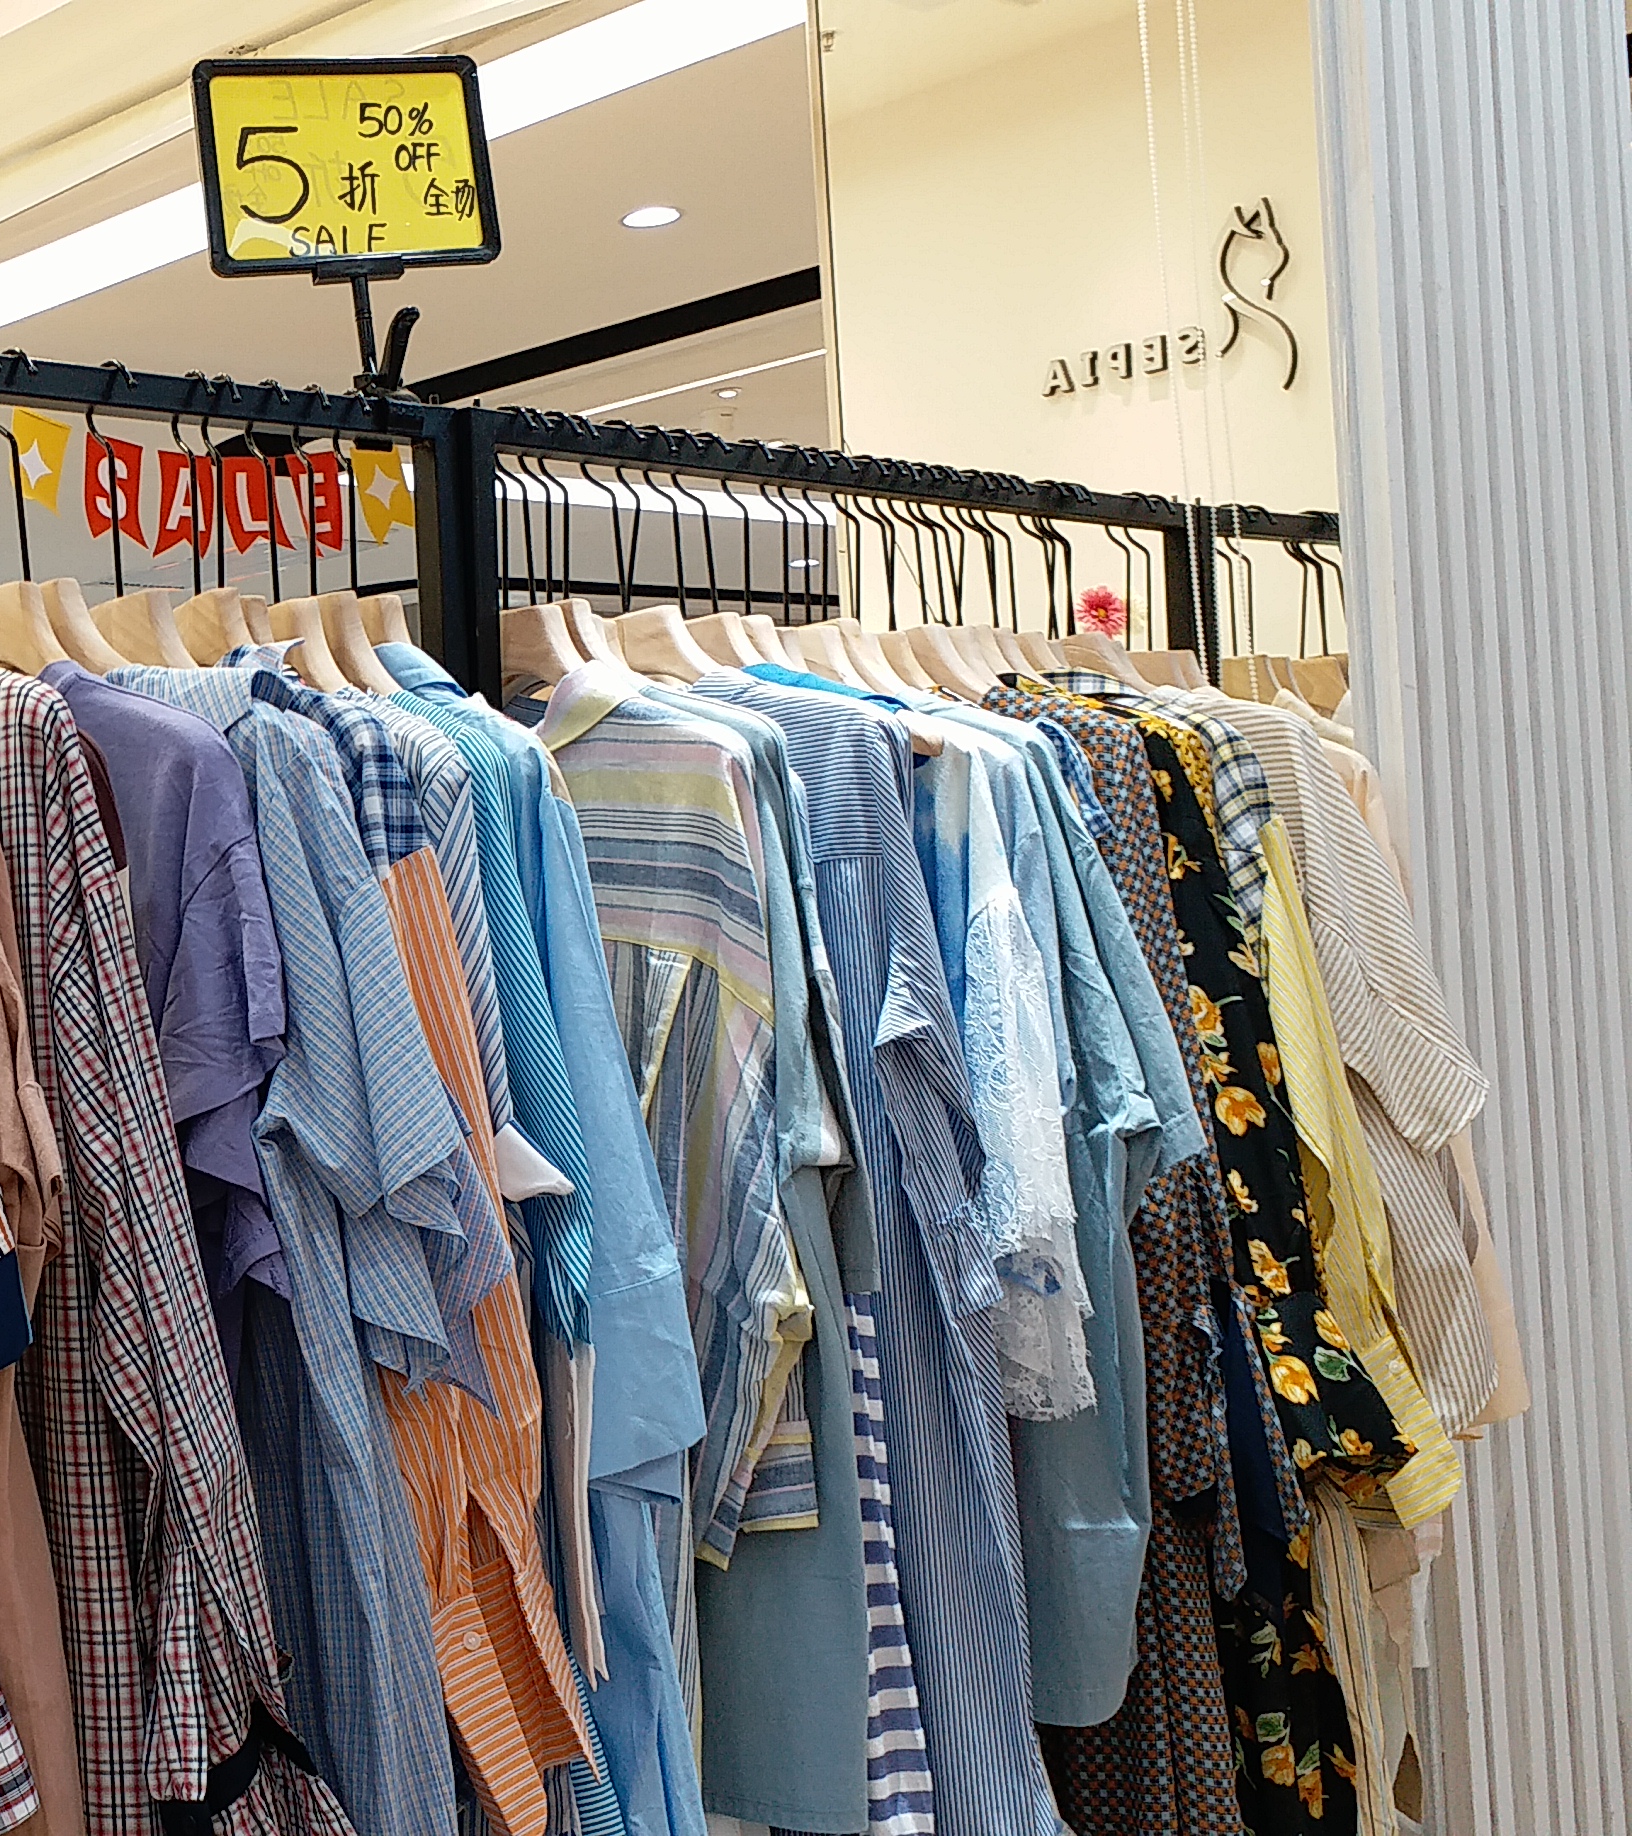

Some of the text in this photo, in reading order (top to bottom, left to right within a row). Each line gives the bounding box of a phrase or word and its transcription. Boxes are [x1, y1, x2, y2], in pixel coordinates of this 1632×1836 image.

[358, 102, 434, 138] 50%
[394, 142, 441, 172] OFF
[95, 456, 333, 534] SALE
